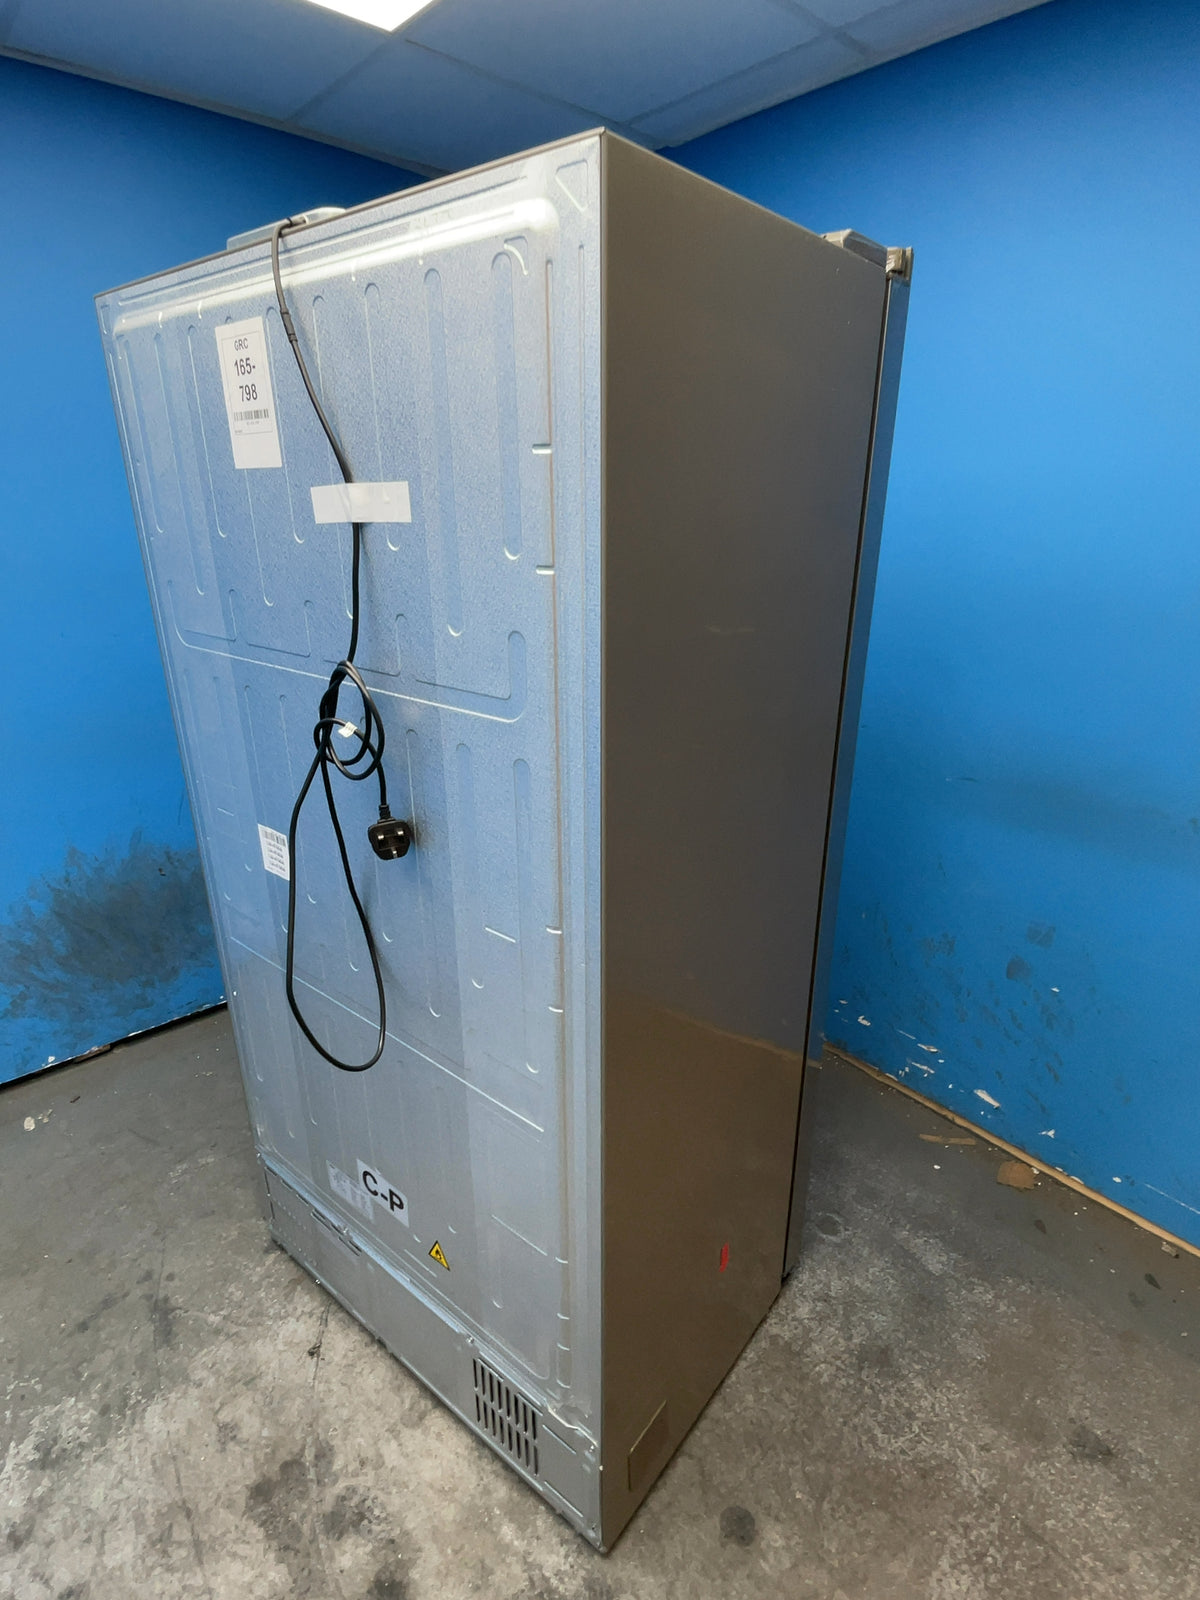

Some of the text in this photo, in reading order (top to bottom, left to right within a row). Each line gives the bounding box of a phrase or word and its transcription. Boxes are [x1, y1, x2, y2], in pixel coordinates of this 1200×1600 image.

[234, 338, 249, 351] GRC
[234, 357, 256, 376] 165-
[239, 383, 258, 402] 798
[362, 1170, 404, 1212] C-P
